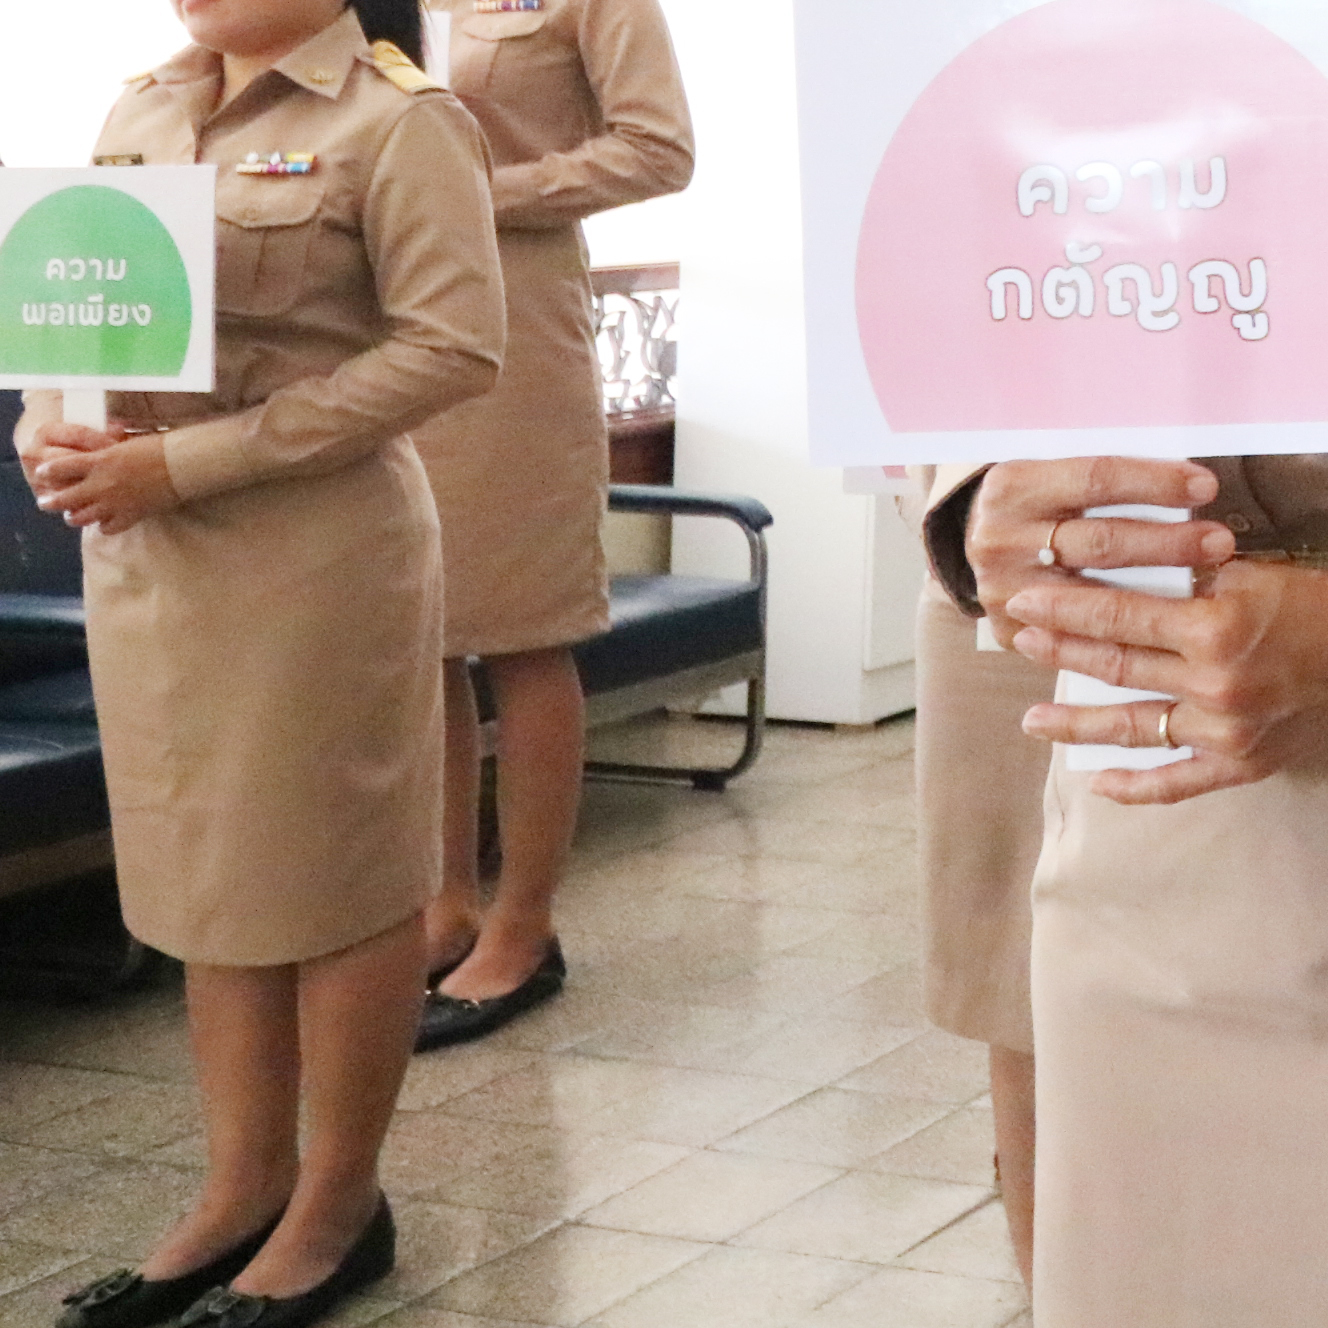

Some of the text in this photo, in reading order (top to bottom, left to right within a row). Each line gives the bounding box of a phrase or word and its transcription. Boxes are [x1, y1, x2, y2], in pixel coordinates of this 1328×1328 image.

[1014, 154, 1229, 218] ความ
[45, 257, 128, 282] ความ
[984, 240, 1270, 342] กตัญญู
[22, 293, 152, 327] พอเพียง
